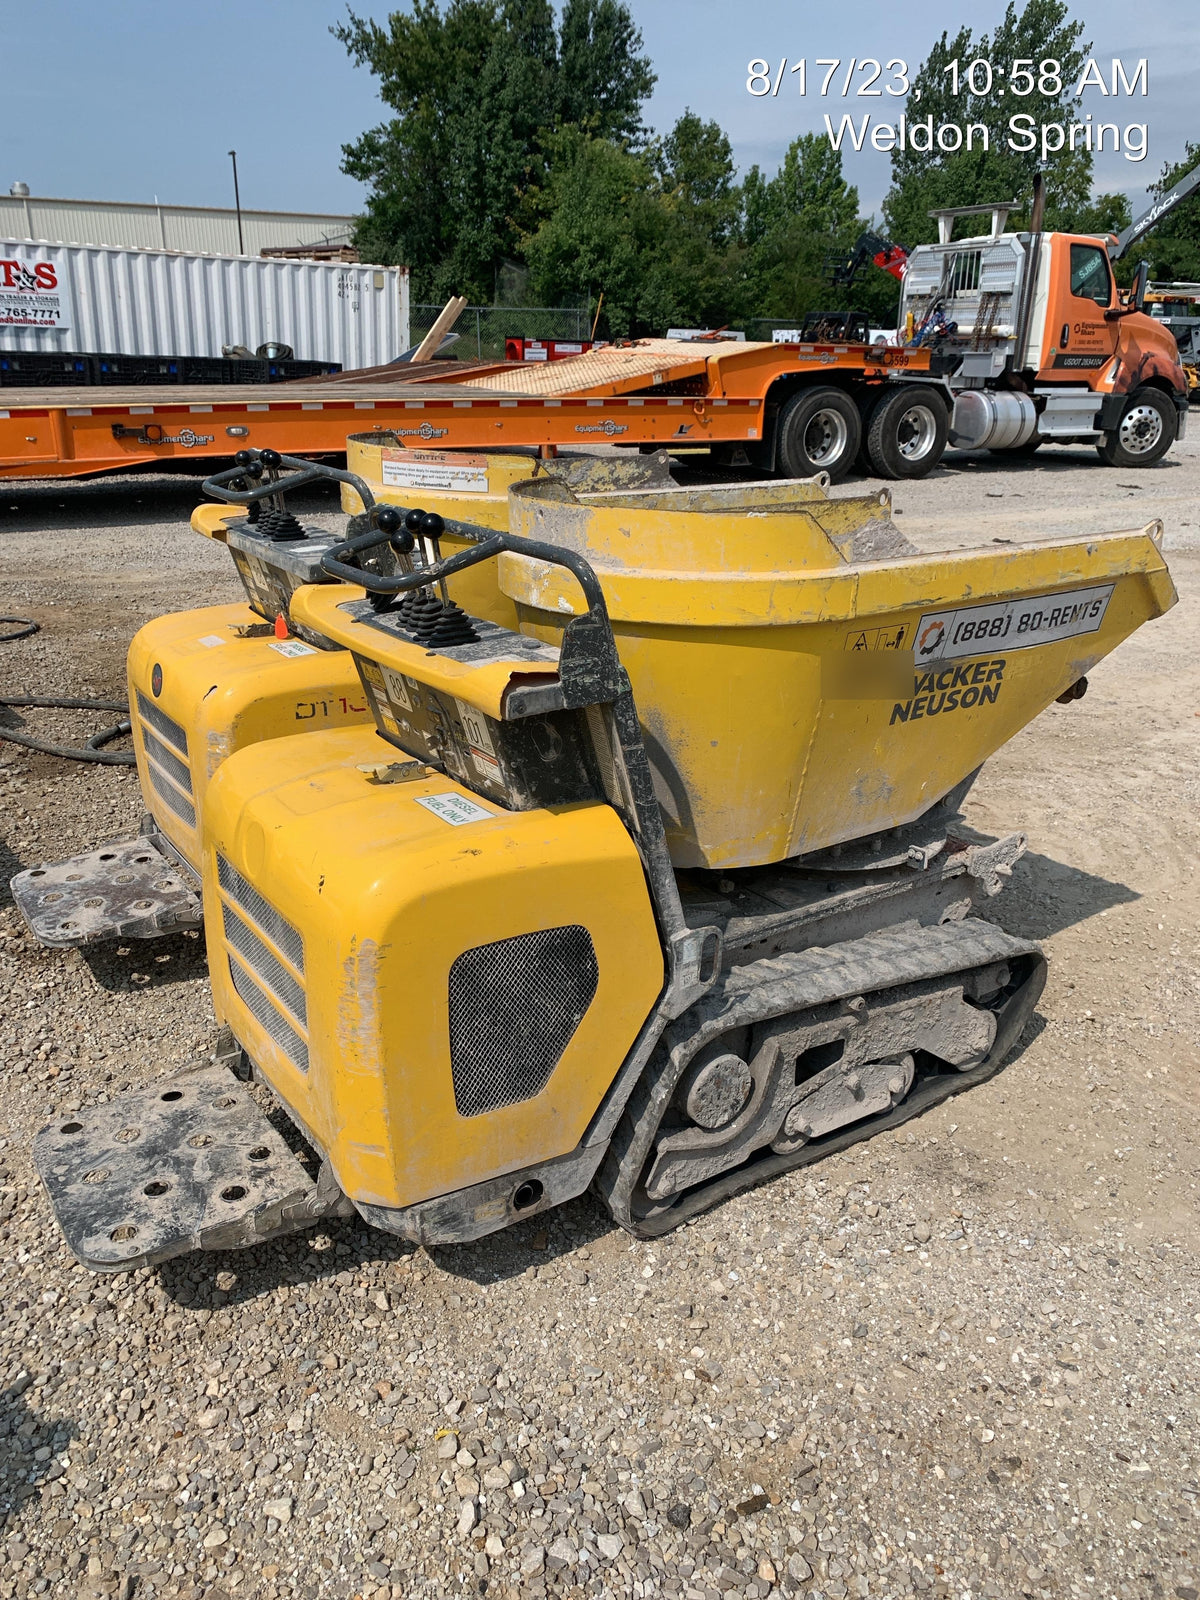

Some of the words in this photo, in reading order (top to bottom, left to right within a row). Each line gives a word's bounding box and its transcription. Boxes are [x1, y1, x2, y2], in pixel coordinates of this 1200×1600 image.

[1133, 192, 1180, 234] SKYJACK
[890, 355, 909, 367] 599
[1063, 358, 1081, 366] USDOT
[137, 432, 215, 445] EqpmentShare
[413, 453, 446, 461] NOTICE
[952, 615, 1013, 645] (888)
[1017, 600, 1103, 633] 80-RENTS
[889, 682, 1003, 726] NEUSON
[462, 713, 486, 748] 101
[422, 797, 447, 811] FUEL
[442, 809, 470, 823] ONLY
[447, 797, 479, 816] DIESEL
